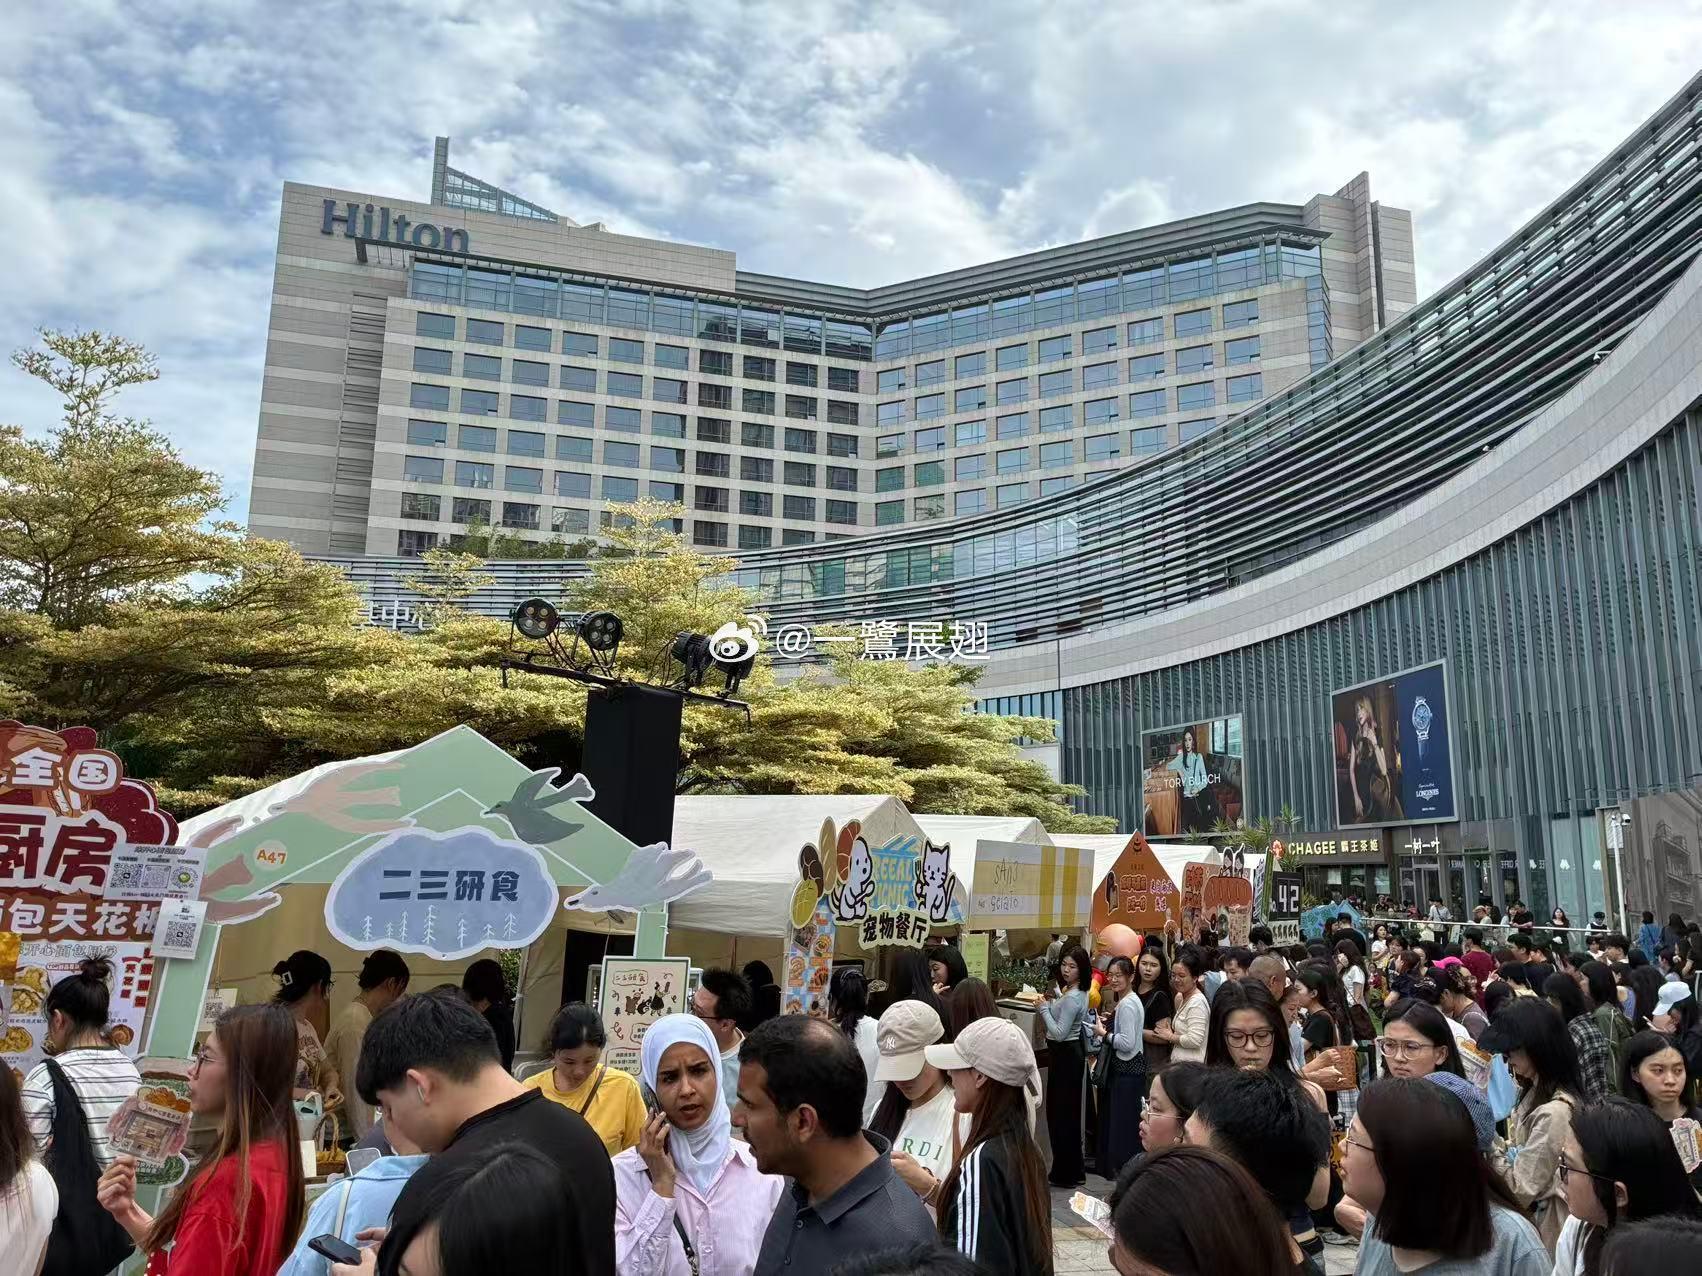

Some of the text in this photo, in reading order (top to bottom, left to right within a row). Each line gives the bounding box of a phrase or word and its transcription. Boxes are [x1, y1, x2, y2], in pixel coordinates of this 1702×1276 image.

[321, 199, 469, 253] Hilton
[0, 747, 117, 791] 全国
[1164, 773, 1221, 788] TORY BURCH
[256, 850, 287, 865] A47
[1288, 839, 1379, 855] CHAGEE 霸王茶姬
[379, 870, 520, 902] 二三研食
[0, 899, 161, 935] 包天花板
[863, 912, 928, 943] 宠物餐厅
[902, 1138, 943, 1161] RDI
